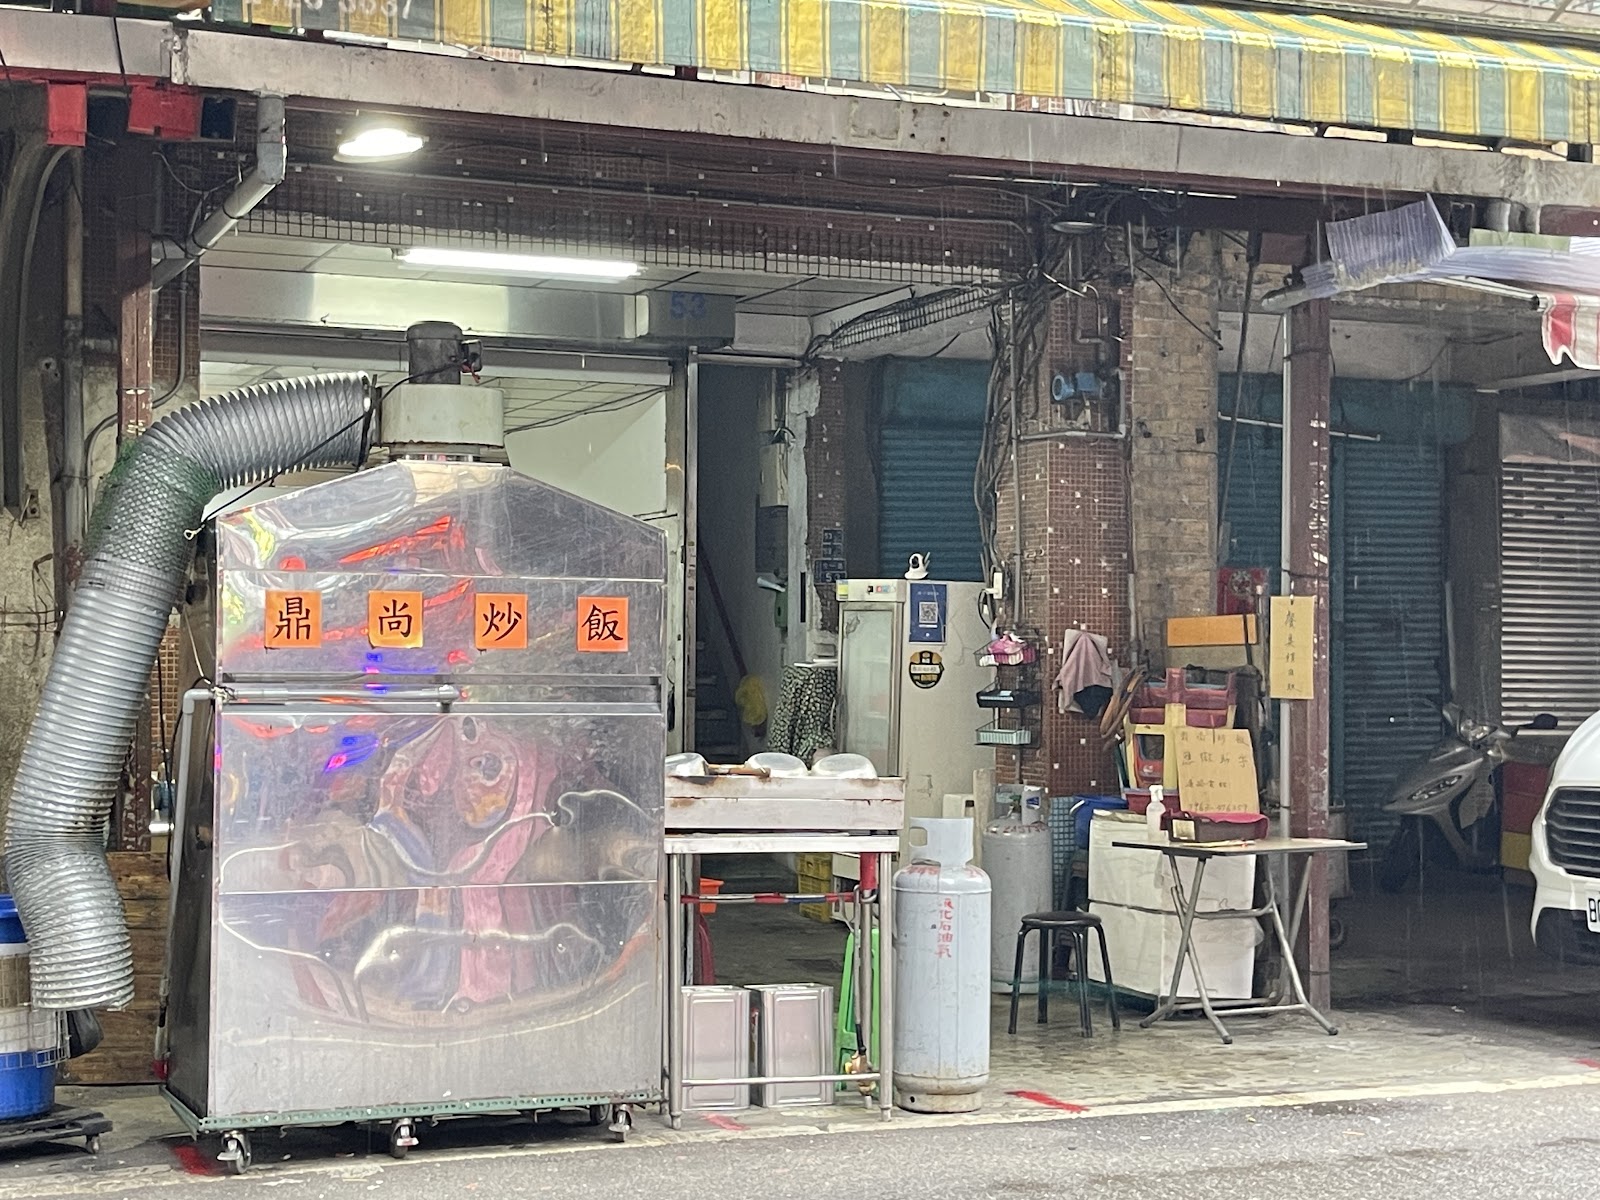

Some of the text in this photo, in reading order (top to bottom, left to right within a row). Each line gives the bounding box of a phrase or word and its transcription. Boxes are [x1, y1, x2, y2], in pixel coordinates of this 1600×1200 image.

[272, 596, 624, 641] 鼎尚炒飯
[1588, 897, 1600, 923] B
